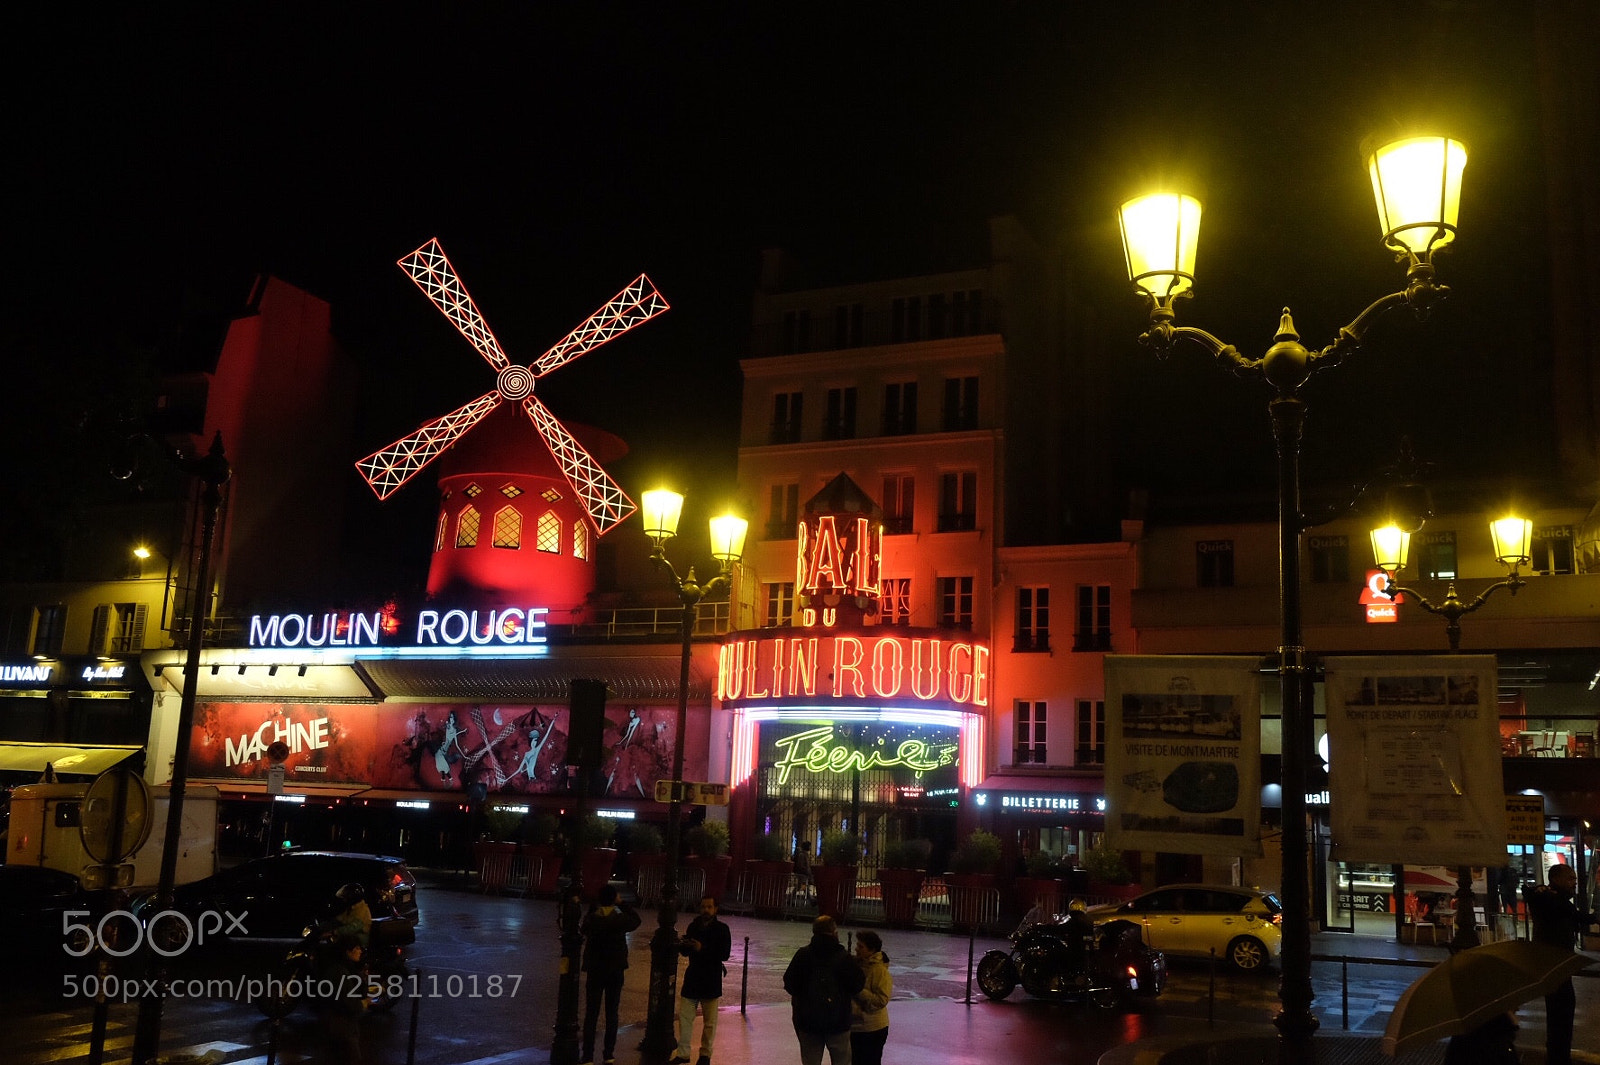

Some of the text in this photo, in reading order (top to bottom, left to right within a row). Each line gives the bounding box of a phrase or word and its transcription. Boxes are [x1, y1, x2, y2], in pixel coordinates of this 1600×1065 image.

[1198, 540, 1233, 554] Quick
[1309, 536, 1347, 550] Quick
[796, 516, 881, 598] BAL
[1369, 573, 1392, 599] Q
[803, 608, 836, 627] DU
[1367, 608, 1396, 618] Quick
[249, 607, 549, 646] MOULIN ROUGE
[833, 637, 990, 707] ROUGE
[1370, 710, 1380, 720] DE
[225, 717, 329, 767] MACHINE
[1125, 743, 1240, 758] VISITE DE MONTMARTRE
[1002, 796, 1079, 809] BILLETTERIE
